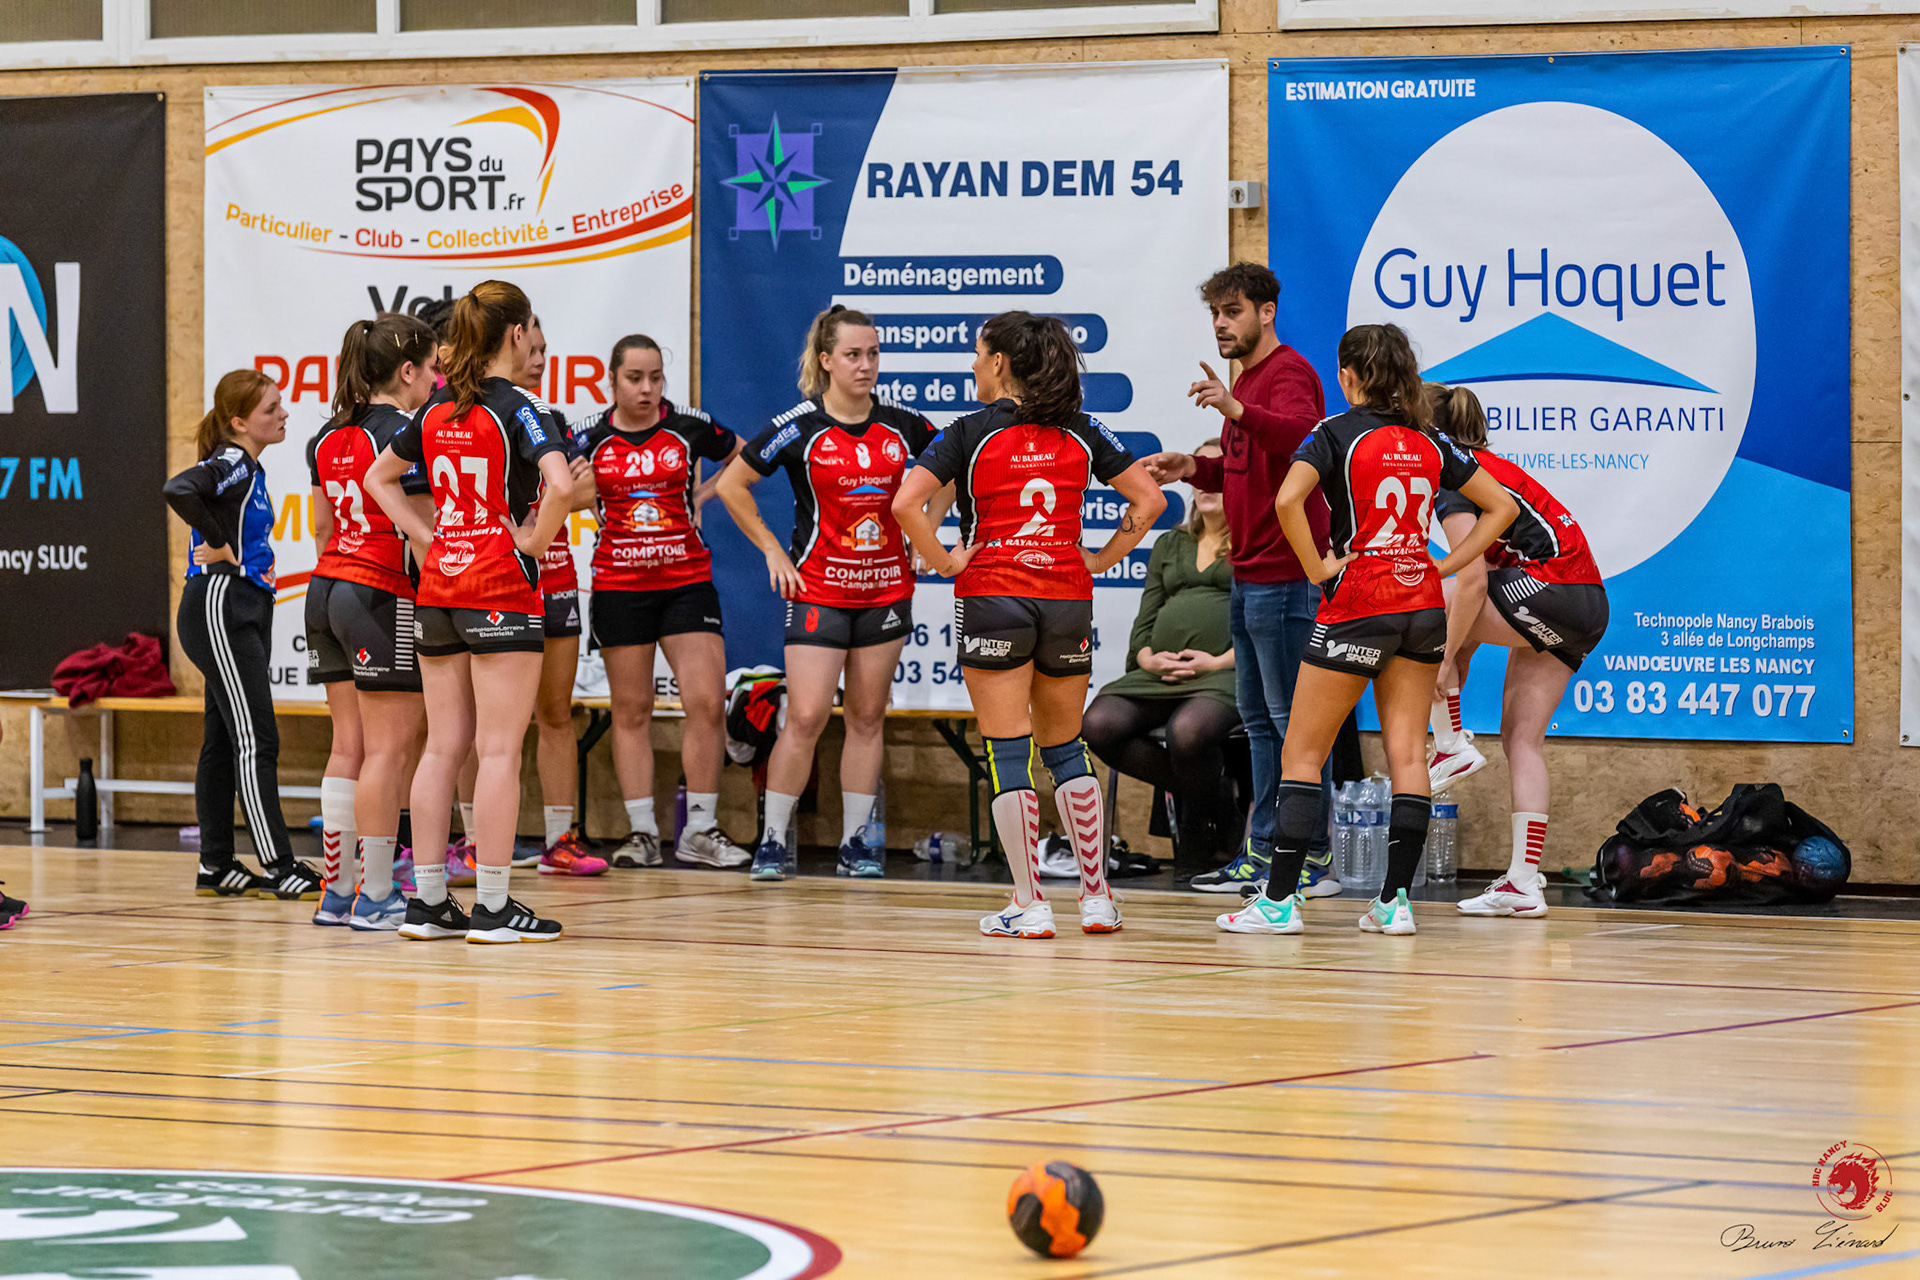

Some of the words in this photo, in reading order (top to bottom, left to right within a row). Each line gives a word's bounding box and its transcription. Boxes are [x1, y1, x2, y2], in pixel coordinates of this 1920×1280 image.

[1286, 80, 1388, 101] ESTIMATION
[1390, 78, 1476, 99] GRATUITE
[356, 138, 473, 174] PAYS
[479, 155, 503, 173] du
[867, 161, 1008, 198] RAYAN
[1021, 159, 1115, 196] DEM
[1131, 159, 1183, 197] 54
[225, 203, 334, 244] Particulier
[355, 228, 403, 248] Club
[427, 219, 549, 249] Collectivité
[571, 182, 685, 235] Entreprise
[844, 262, 1045, 292] Déménagement
[1374, 246, 1488, 323] Guy
[1508, 246, 1726, 322] Hoquet
[875, 320, 969, 349] ansport
[924, 378, 956, 402] de
[1487, 407, 1578, 431] BILIER
[1590, 406, 1725, 432] GARANTI
[623, 449, 655, 478] 28
[1010, 455, 1021, 463] AU
[1022, 452, 1056, 462] BUREAU
[1382, 453, 1393, 461] AU
[1393, 453, 1422, 462] BUREAU
[30, 457, 83, 500] FM
[432, 455, 488, 526] 27
[1019, 477, 1057, 537] 2
[1365, 476, 1433, 548] 27
[38, 545, 88, 570] SLUC
[612, 543, 686, 559] COMPTOIR
[861, 558, 873, 566] LE
[824, 565, 902, 581] COMPTOIR
[1534, 622, 1564, 645] INTER
[1634, 612, 1713, 631] Technopole
[1717, 613, 1758, 633] Nancy
[1761, 614, 1815, 631] Brabois
[980, 637, 1012, 651] INTER
[1347, 643, 1381, 658] INTER
[1661, 632, 1669, 647] 3
[1673, 632, 1704, 647] allée
[1708, 632, 1724, 648] de
[1727, 633, 1816, 652] Longchamps
[1345, 654, 1380, 666] SPORT
[1720, 657, 1751, 674] LES
[1755, 658, 1816, 675] NANCY
[269, 666, 298, 685] UE
[1574, 680, 1615, 714] 03
[1626, 681, 1667, 715] 83
[1678, 682, 1741, 716] 447
[1752, 684, 1816, 717] 077
